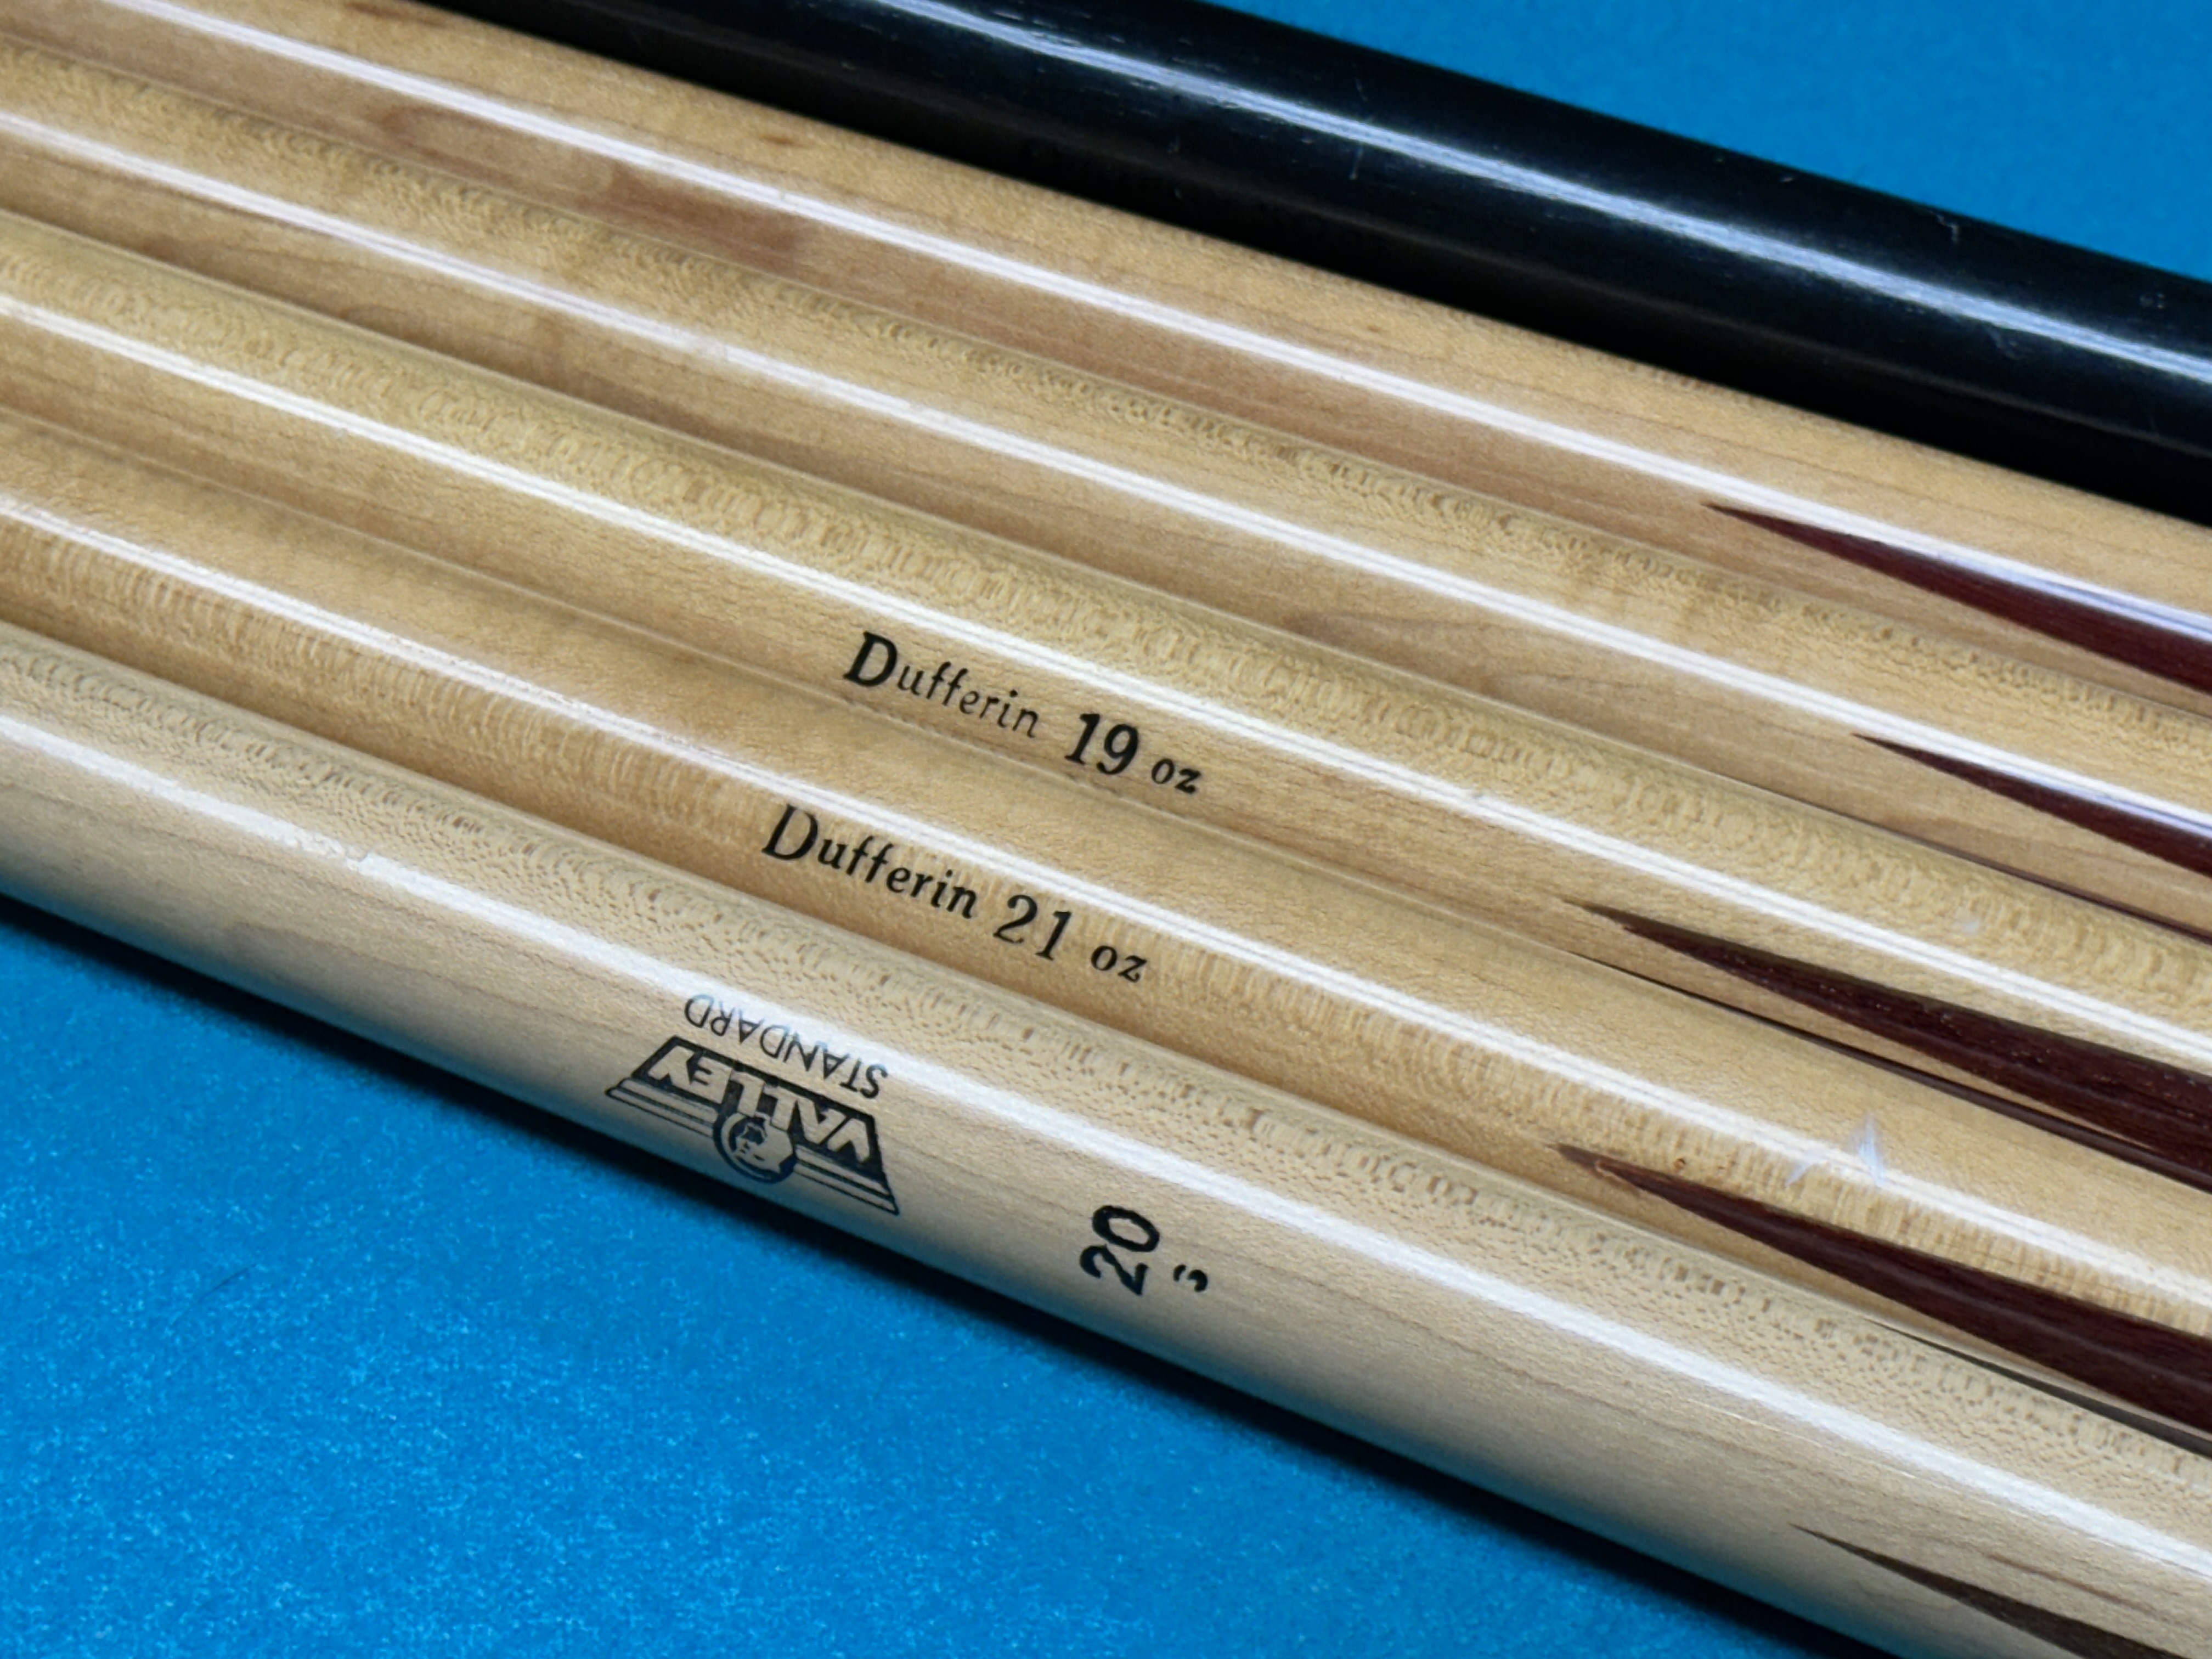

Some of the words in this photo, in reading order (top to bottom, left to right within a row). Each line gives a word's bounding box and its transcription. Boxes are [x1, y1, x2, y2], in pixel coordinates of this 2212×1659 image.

[843, 630, 1040, 738] Dufferin
[1065, 713, 1140, 776] 19
[1150, 758, 1203, 795] oz
[761, 804, 978, 919] Dufferin
[992, 894, 1073, 962] 21
[1090, 945, 1148, 984] oz
[648, 1041, 871, 1163] VALLEY
[684, 994, 889, 1099] STANDARD
[1079, 1205, 1160, 1296] 20
